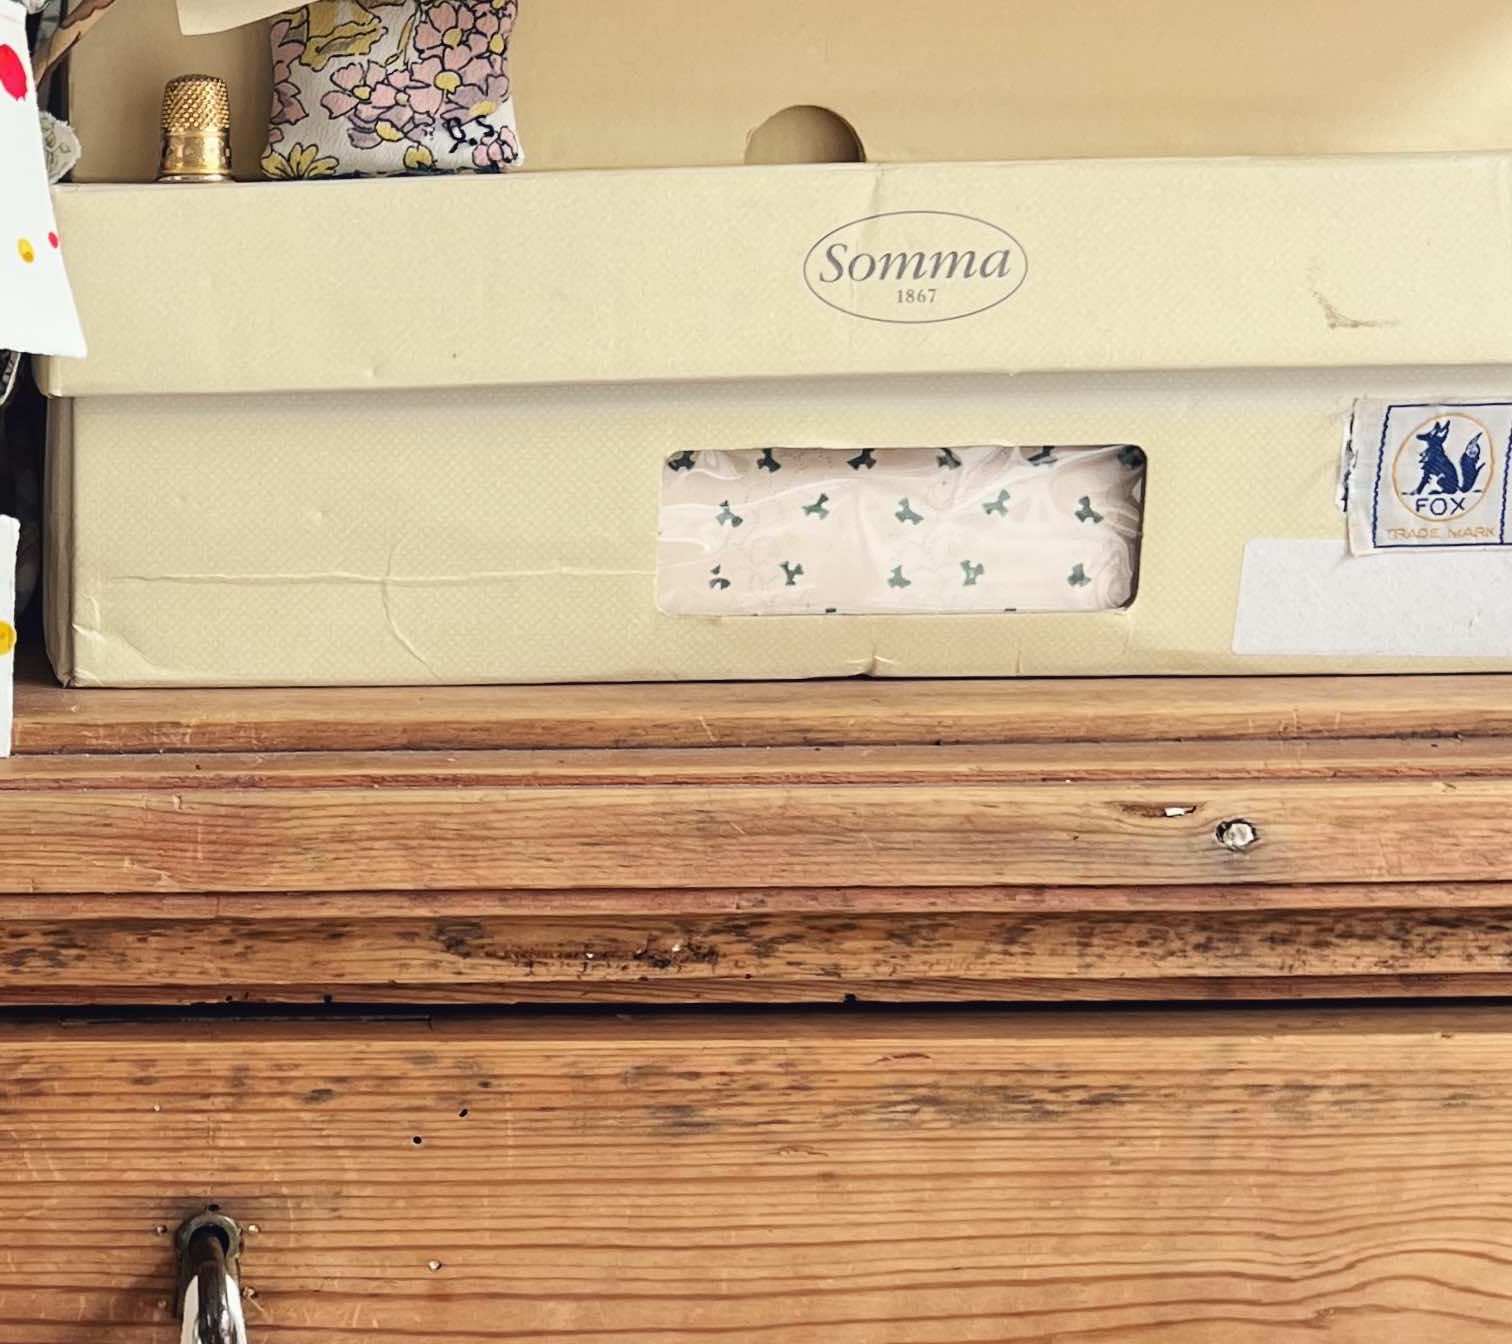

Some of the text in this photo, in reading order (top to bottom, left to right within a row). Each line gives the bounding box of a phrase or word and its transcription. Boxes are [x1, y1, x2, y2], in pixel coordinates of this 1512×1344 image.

[818, 242, 1011, 284] Somma
[896, 288, 937, 304] 1867
[1415, 497, 1466, 516] FOX
[1387, 525, 1496, 540] TRADE MARK
